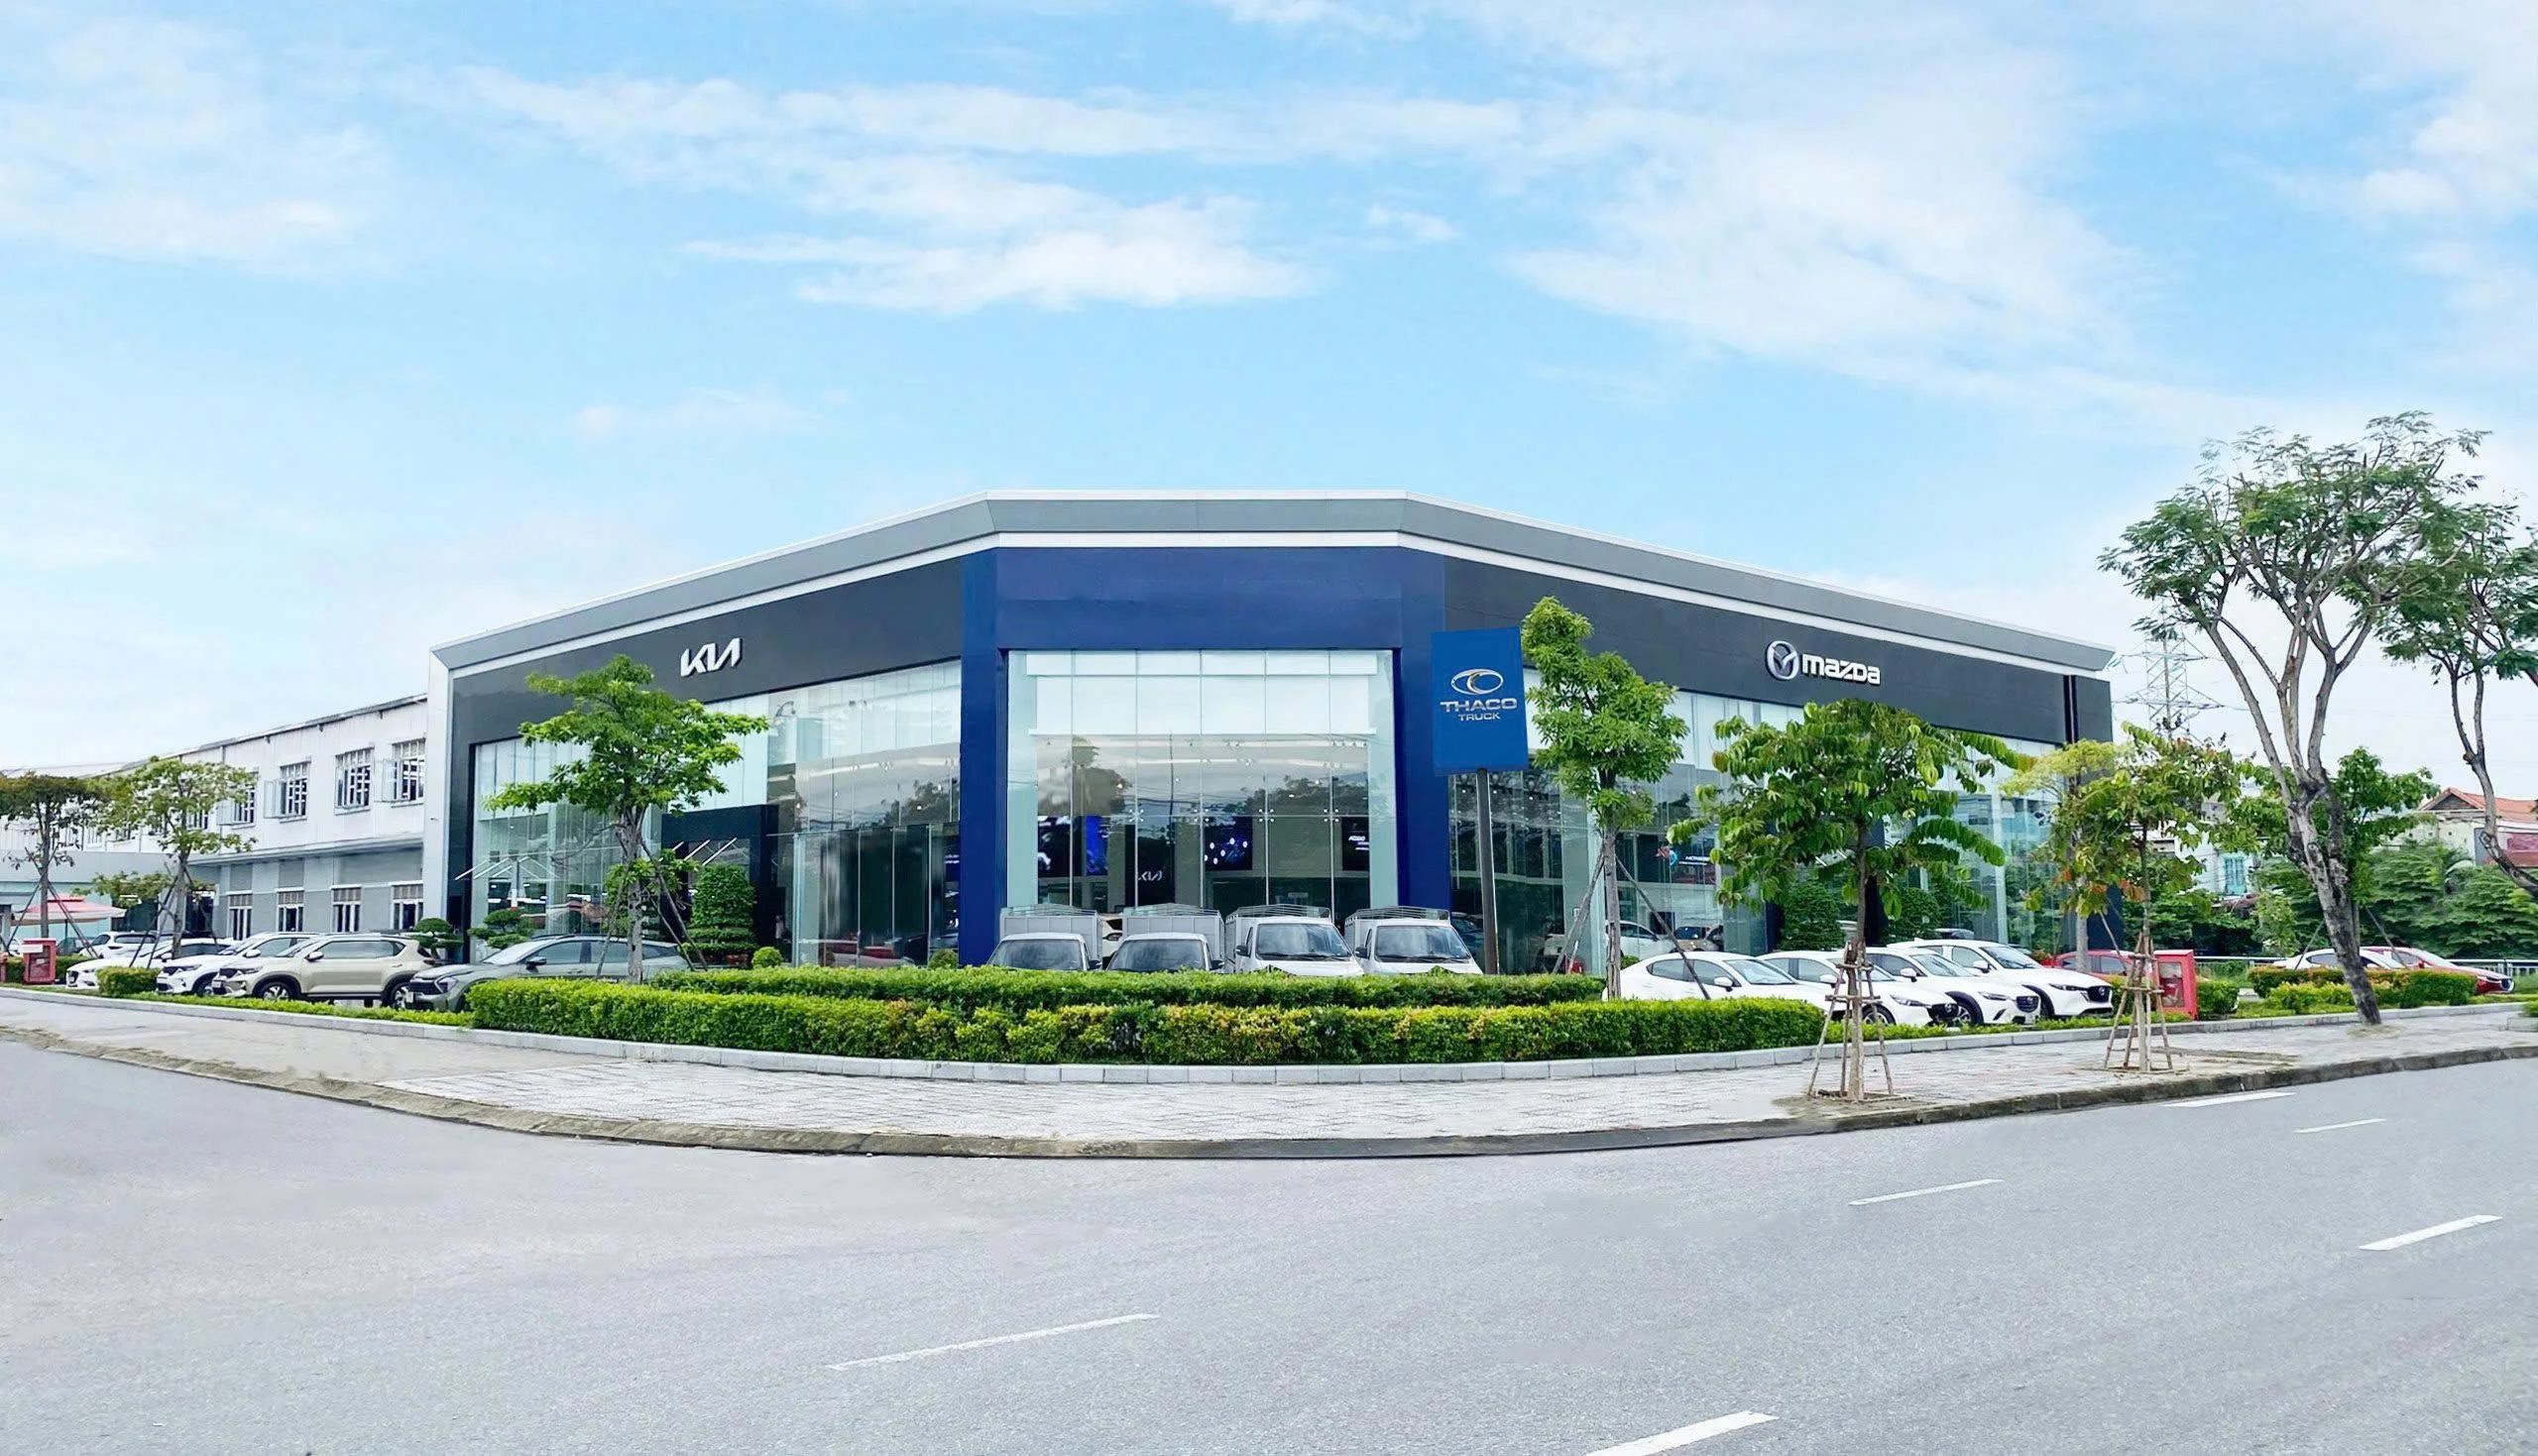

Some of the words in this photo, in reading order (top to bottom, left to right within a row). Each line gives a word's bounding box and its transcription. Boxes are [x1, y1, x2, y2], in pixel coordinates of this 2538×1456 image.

[680, 637, 741, 677] KIA
[1802, 653, 1881, 685] mazda
[1440, 698, 1518, 713] THACO
[1457, 712, 1501, 722] TRUCK
